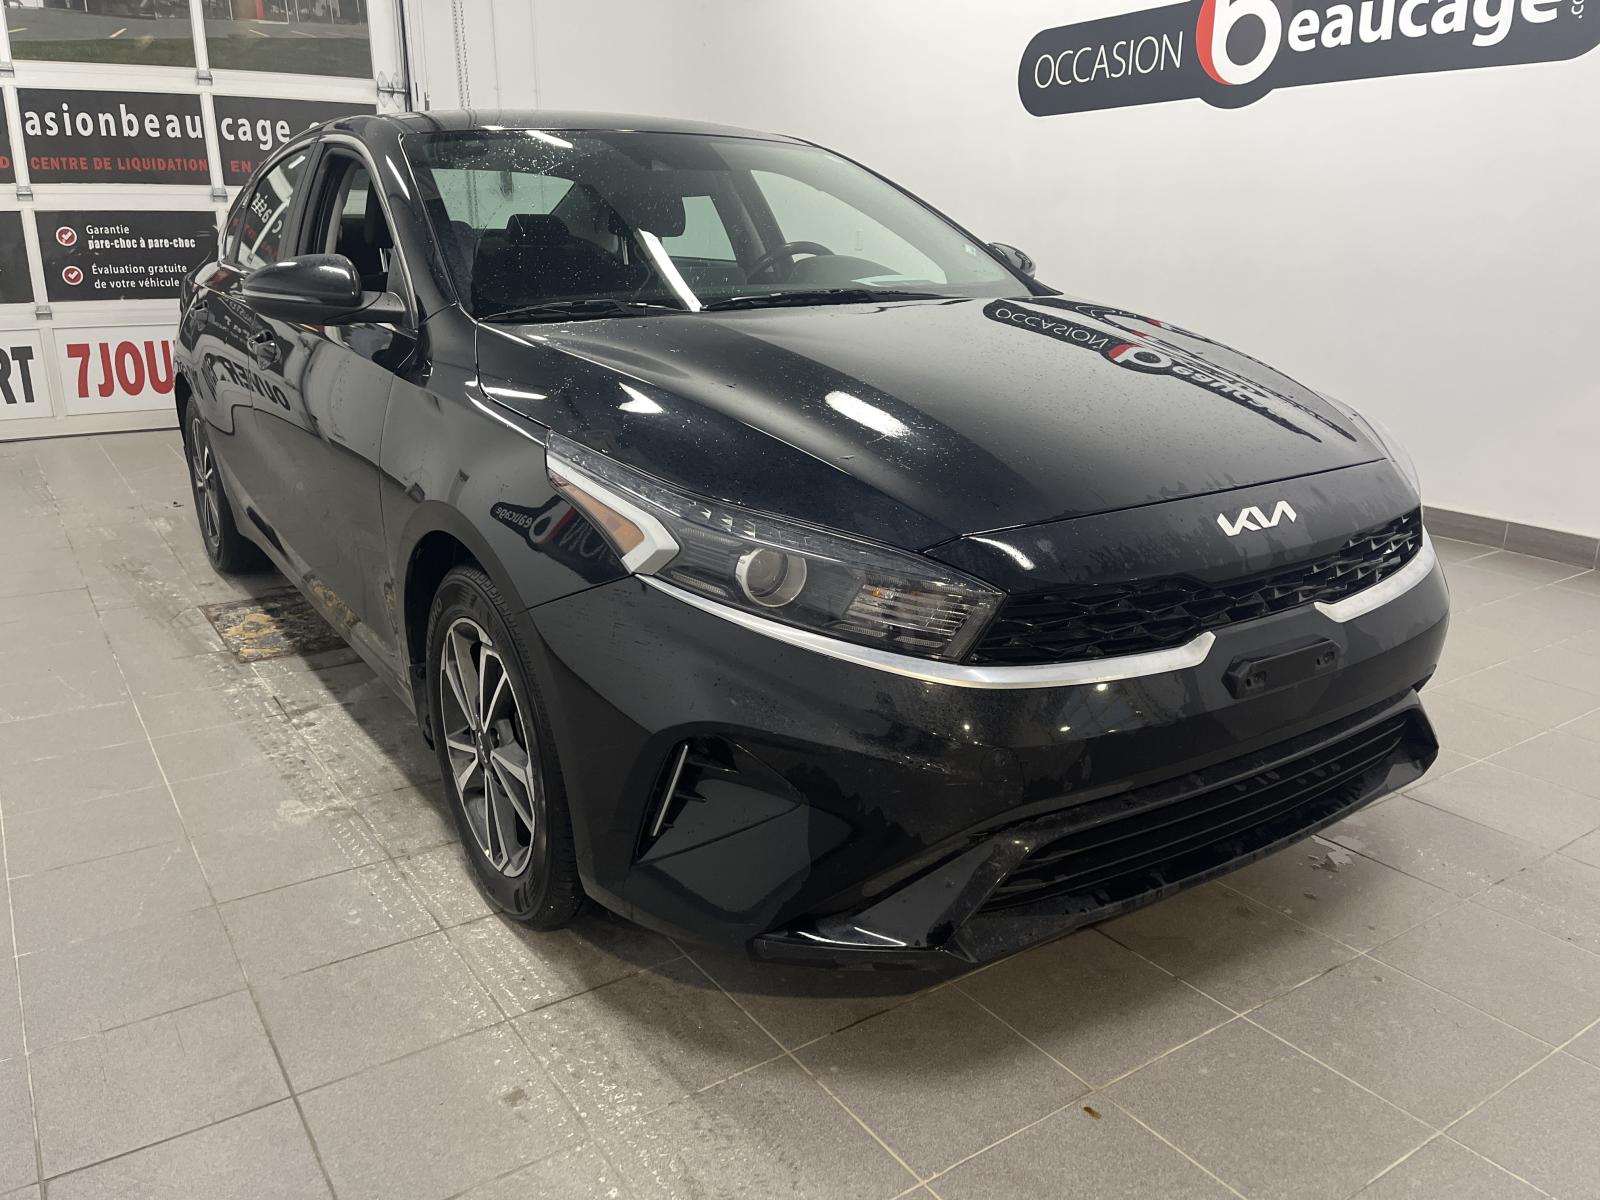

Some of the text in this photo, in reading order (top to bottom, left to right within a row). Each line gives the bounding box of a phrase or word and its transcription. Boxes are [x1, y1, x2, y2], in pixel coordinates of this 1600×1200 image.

[1034, 32, 1183, 89] OCCASION
[31, 156, 87, 170] CENTRE
[93, 157, 113, 170] DE
[117, 157, 210, 171] LIQUIDATION
[230, 160, 252, 173] EN
[86, 225, 130, 235] Garantie
[88, 236, 196, 250] pare-choc à pare-choc
[92, 263, 187, 275] Évaluation gratuite
[94, 277, 180, 289] de votre véhicule
[1217, 500, 1297, 537] KIA
